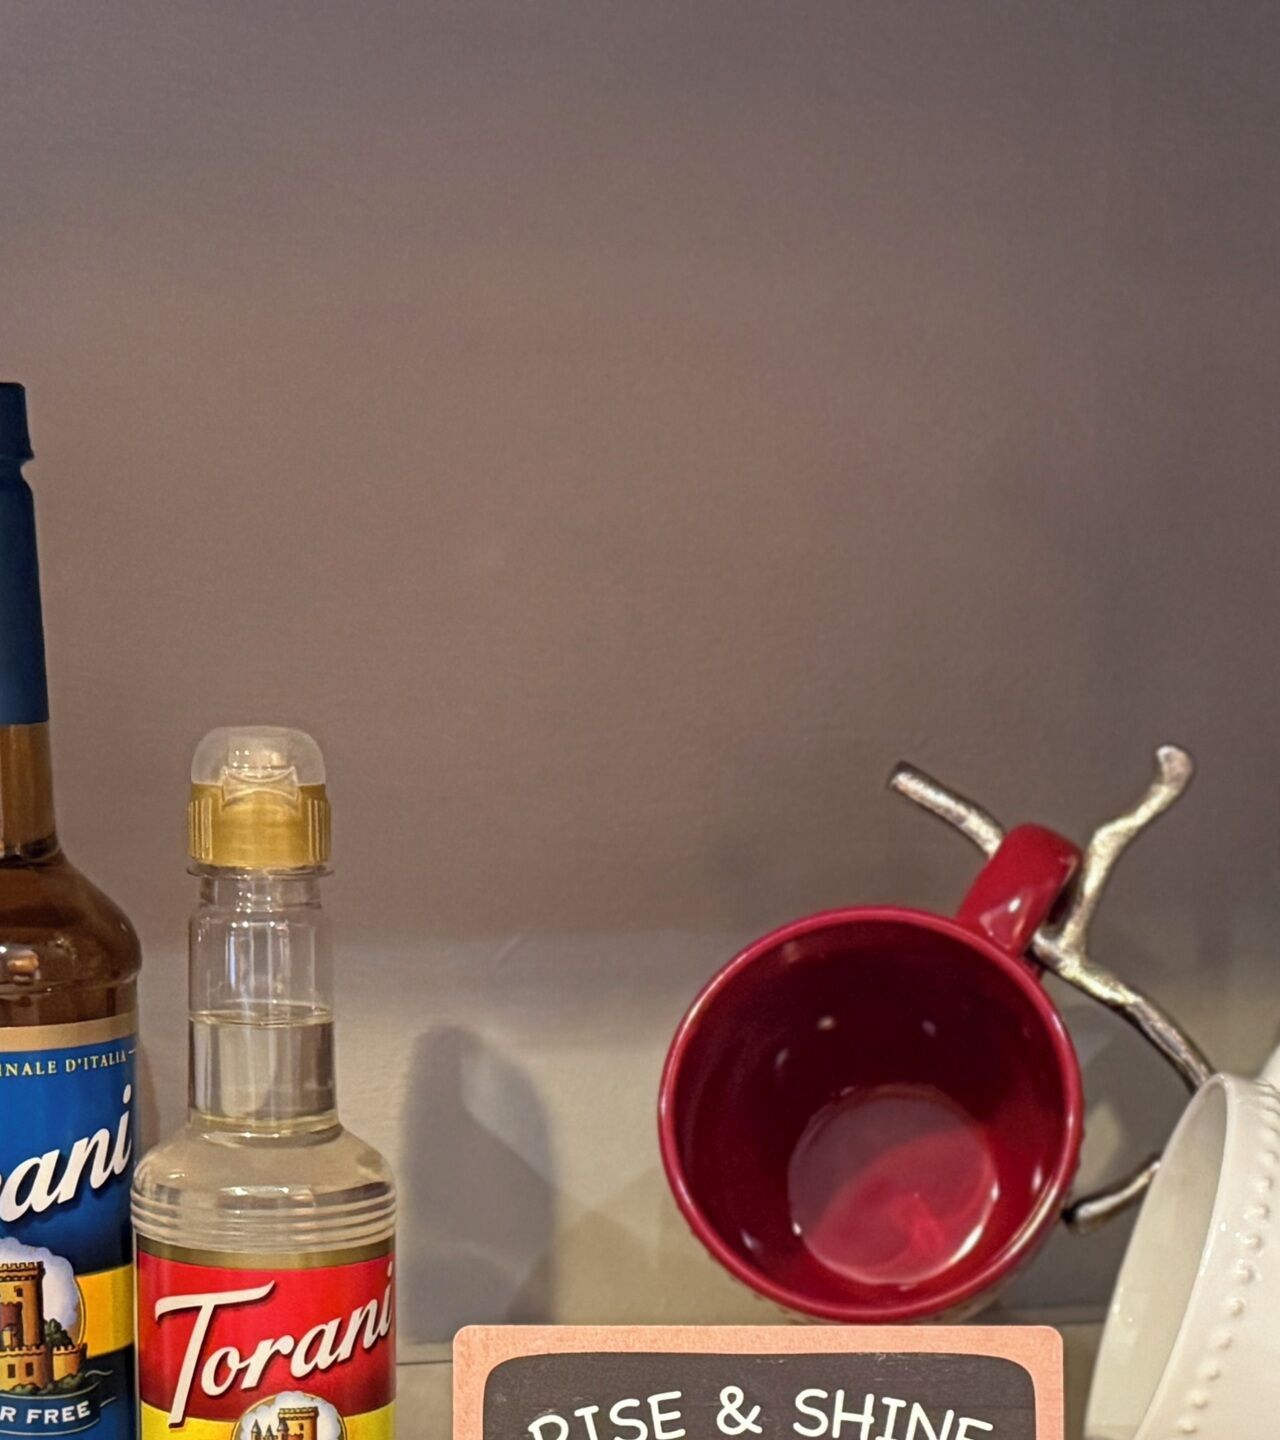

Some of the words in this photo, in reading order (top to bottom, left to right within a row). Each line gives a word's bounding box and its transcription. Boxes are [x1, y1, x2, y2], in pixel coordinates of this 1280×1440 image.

[65, 1050, 128, 1073] D'ITALIA
[154, 1261, 393, 1428] Torani
[26, 1401, 91, 1424] FREE
[716, 1385, 763, 1436] &
